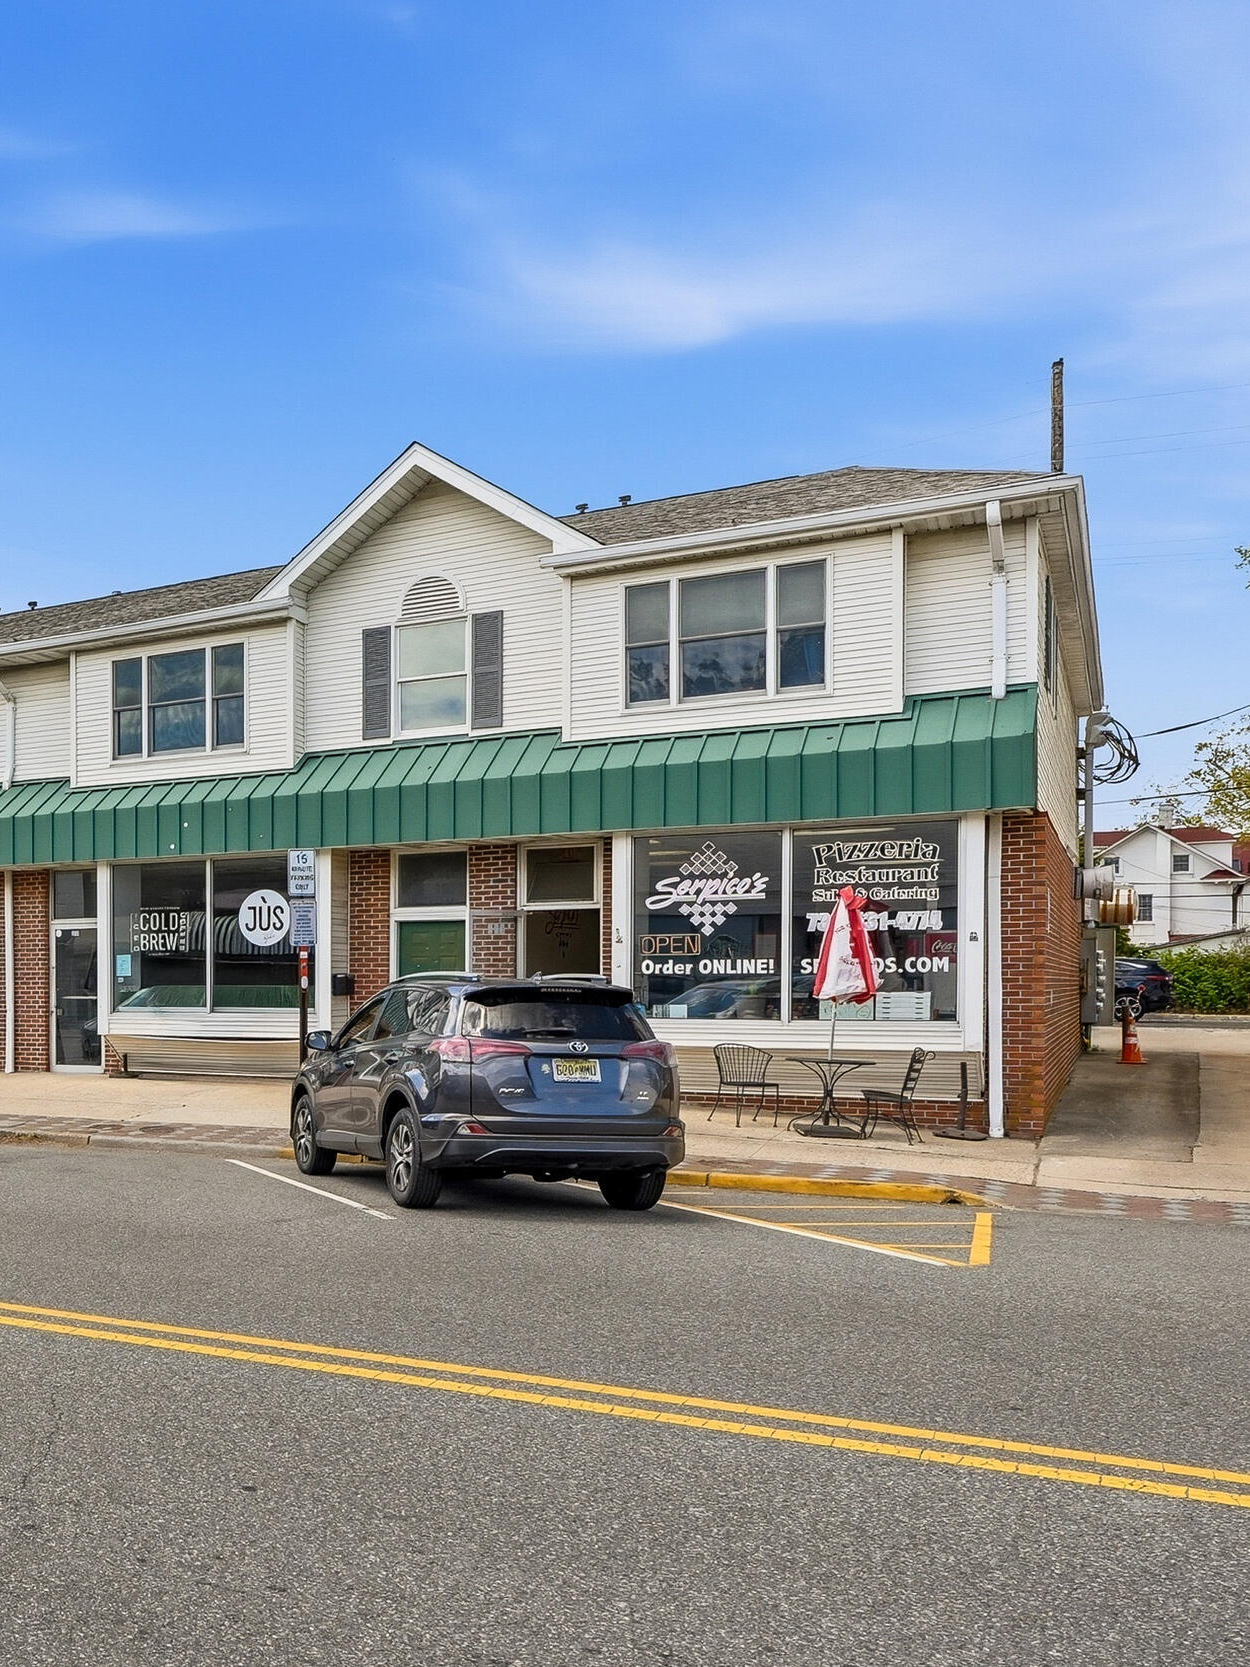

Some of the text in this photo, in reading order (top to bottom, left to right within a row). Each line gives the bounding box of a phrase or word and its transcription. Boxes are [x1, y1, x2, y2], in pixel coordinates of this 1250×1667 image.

[296, 853, 308, 864] 15
[812, 837, 940, 867] Pizzeria
[814, 863, 940, 885] Restaurant
[645, 872, 769, 910] Serpico's
[870, 886, 940, 900] Catering
[140, 913, 178, 931] COLD
[140, 932, 178, 951] BREW
[642, 936, 698, 953] OPEN
[641, 959, 775, 975] Order ONLINE!
